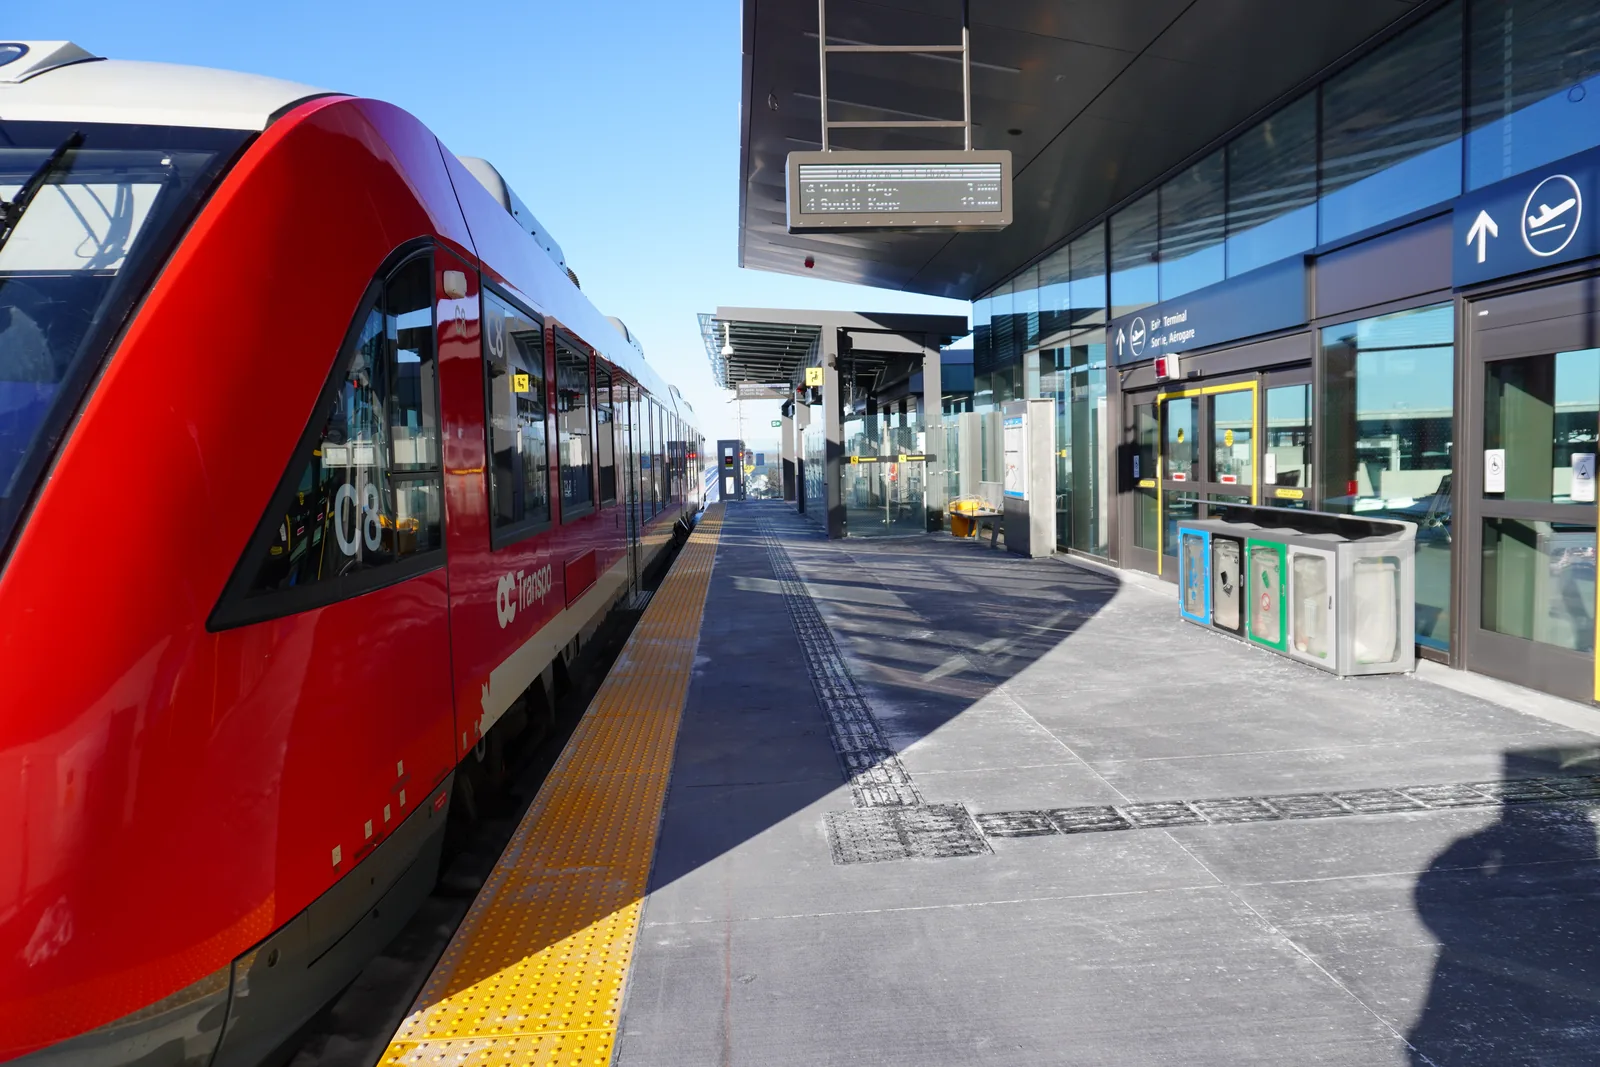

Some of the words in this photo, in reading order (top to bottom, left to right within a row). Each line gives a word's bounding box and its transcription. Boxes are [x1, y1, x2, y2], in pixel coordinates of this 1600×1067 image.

[454, 305, 466, 338] C8
[487, 310, 504, 358] C8
[1163, 309, 1187, 327] Terminal
[1169, 328, 1195, 343] Aérogare
[334, 483, 382, 556] C8
[517, 563, 551, 612] Transpo
